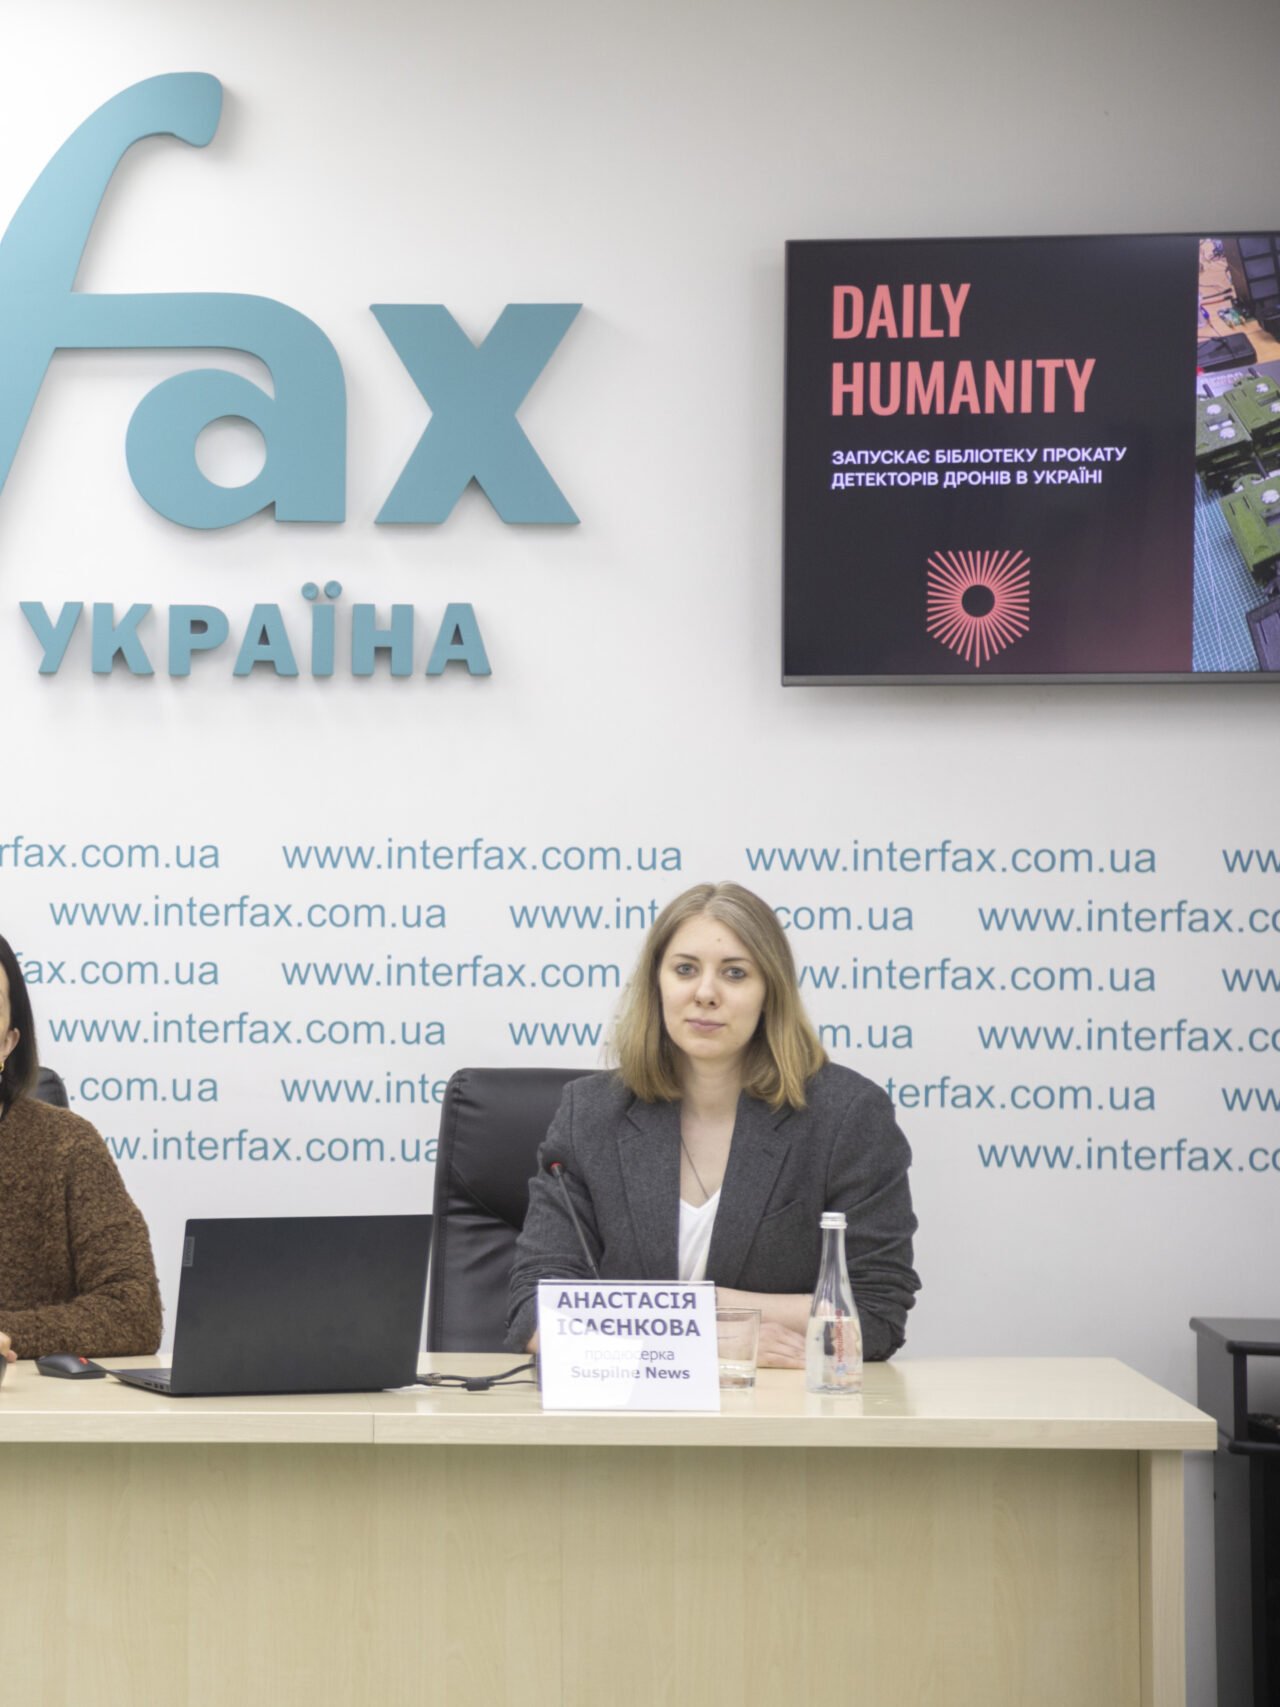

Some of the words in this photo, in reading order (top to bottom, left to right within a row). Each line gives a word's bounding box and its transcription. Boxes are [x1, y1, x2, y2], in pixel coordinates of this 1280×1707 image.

[831, 282, 971, 340] DAILY
[830, 358, 1097, 417] HUMANITY
[831, 449, 930, 466] ЗАПУСКАЄ
[934, 448, 1038, 464] БІБЛІОТЕКУ
[1042, 446, 1128, 463] ПРОКАТУ
[830, 471, 939, 490] ДЕТЕКТОРІВ
[942, 470, 1012, 489] ДРОНІВ
[1015, 470, 1029, 485] В
[1033, 465, 1103, 485] УКРАЇНІ
[20, 579, 492, 677] УКРАЇНА
[281, 836, 683, 872] www.interfax.com.ua
[744, 839, 1157, 874] www.interfax.com.ua
[48, 894, 447, 930] www.interfax.com.ua
[47, 1011, 447, 1047] www.interfax.com.ua
[557, 1291, 697, 1309] АНАСТАСІЯ
[556, 1318, 701, 1337] ІСАЄНКОВА
[570, 1365, 641, 1382] Suspilne
[645, 1366, 691, 1380] News
